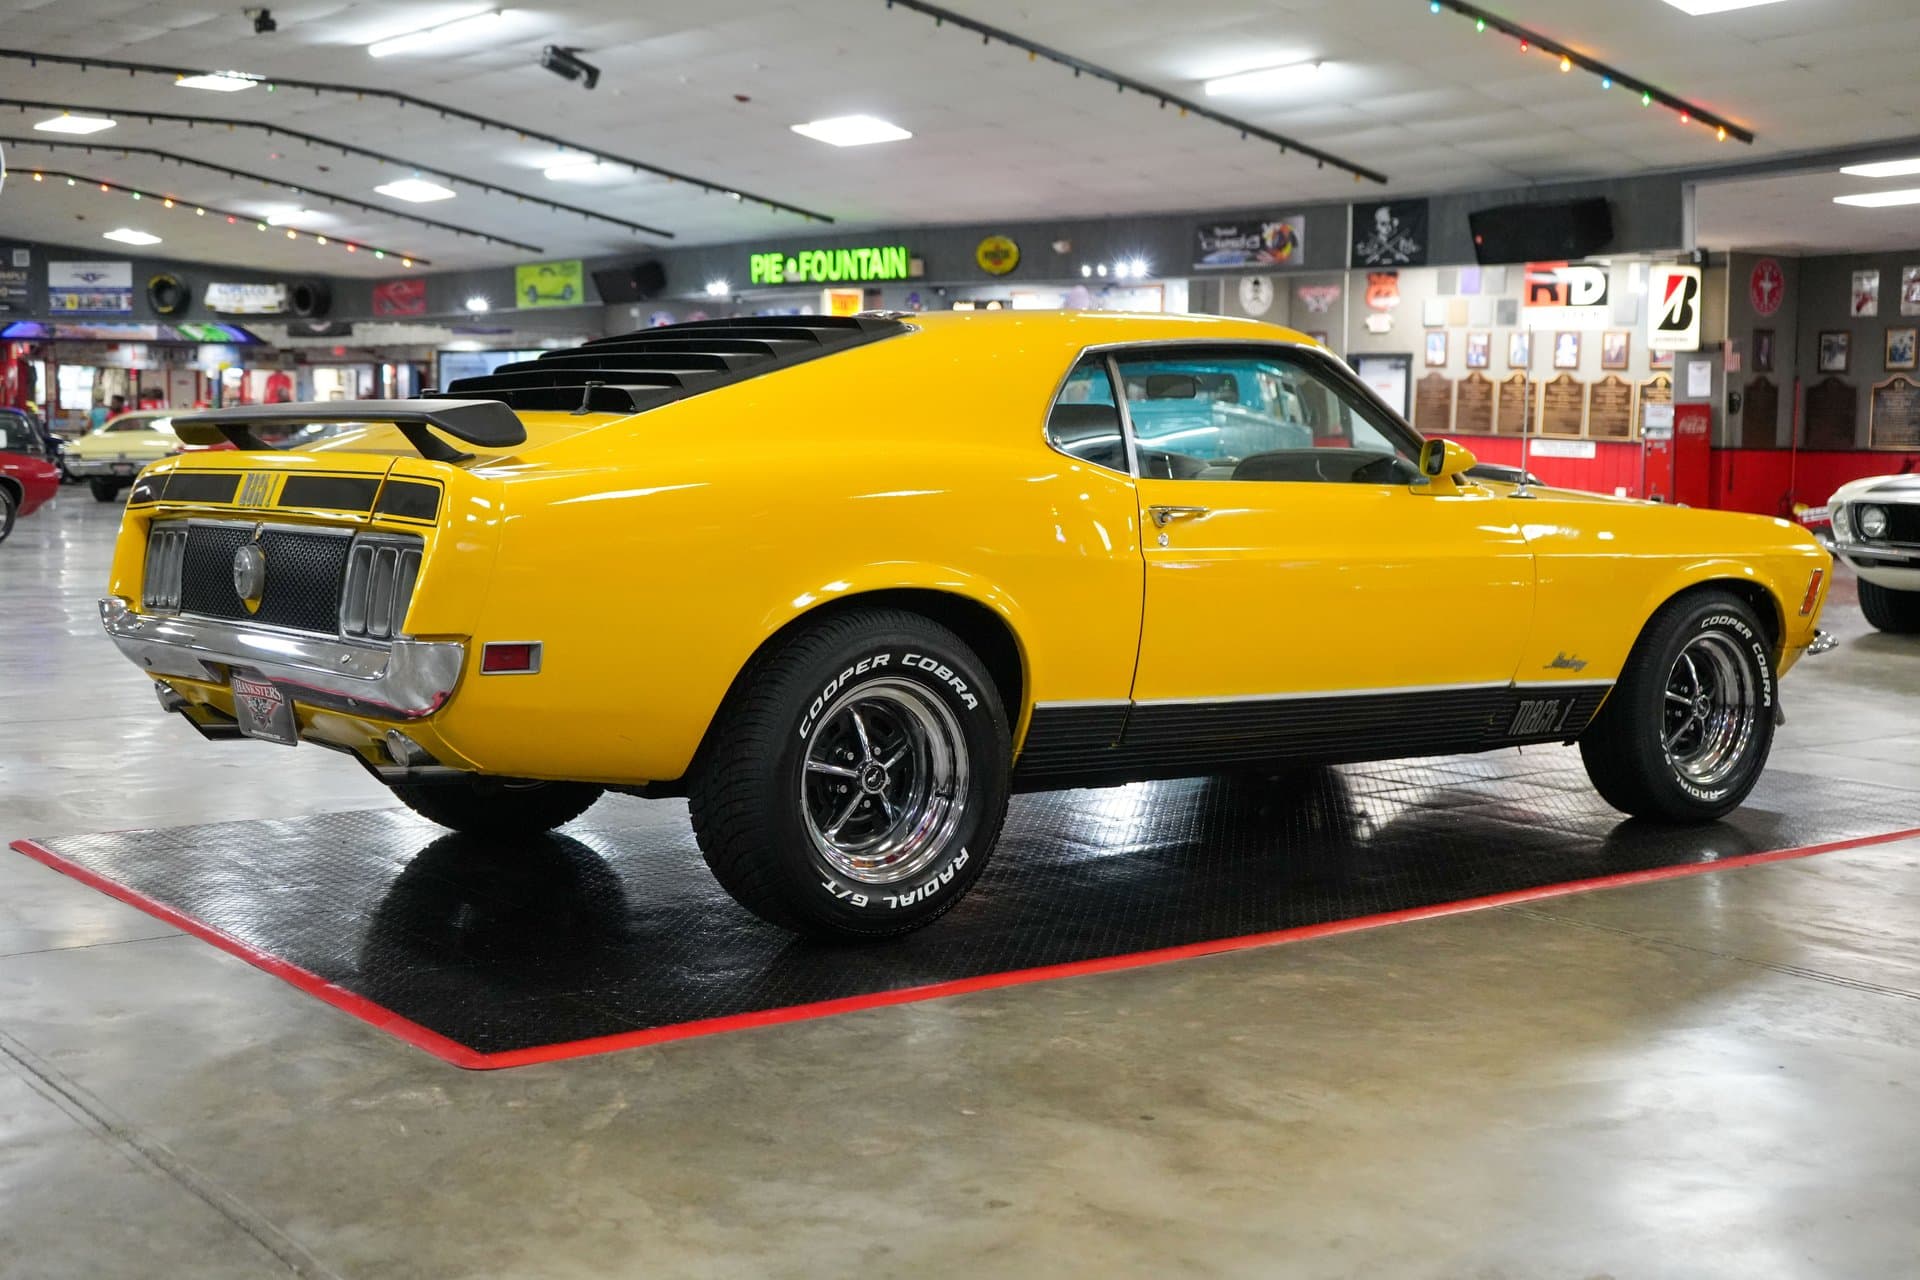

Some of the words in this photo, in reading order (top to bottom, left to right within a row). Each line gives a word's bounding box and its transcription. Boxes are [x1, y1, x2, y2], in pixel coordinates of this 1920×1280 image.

[751, 253, 783, 284] PIE
[800, 246, 907, 283] FOUNTAIN
[1701, 615, 1752, 640] COOPER
[1752, 642, 1771, 708] COBRA
[234, 679, 281, 702] HANKSTERS
[800, 653, 891, 739] COOPER
[901, 653, 979, 711] COBRA
[1675, 771, 1724, 800] RADIAL
[821, 879, 869, 908] G/T
[882, 846, 970, 909] RADIAL
